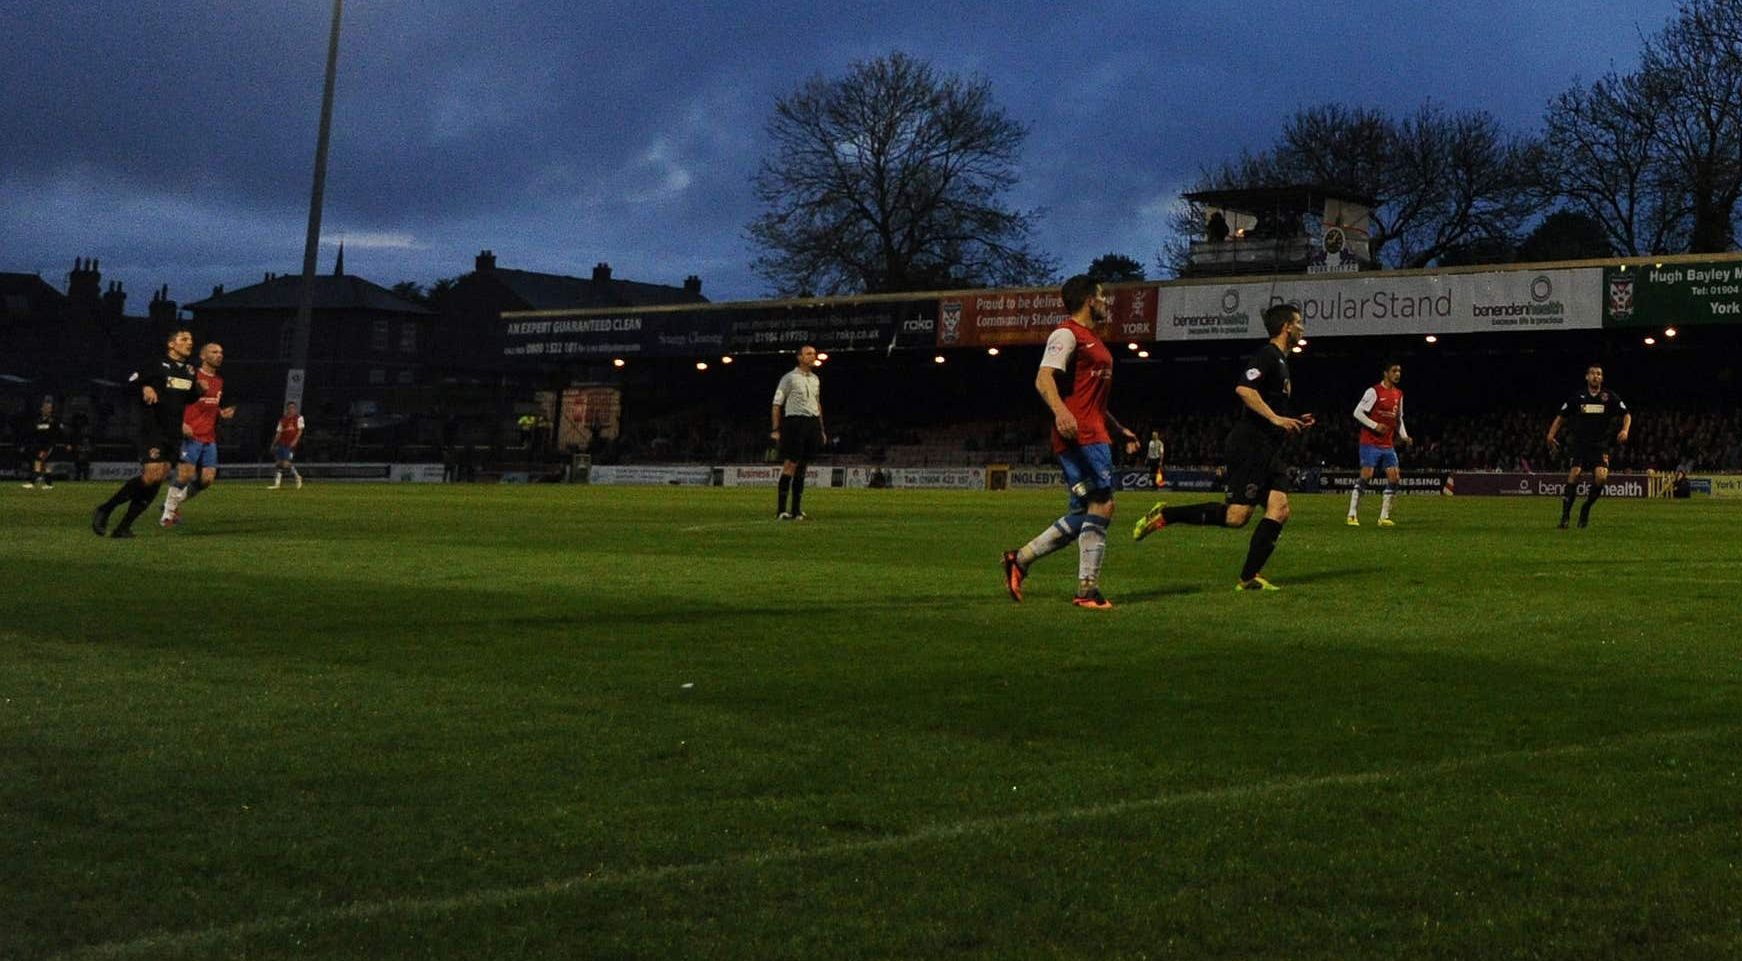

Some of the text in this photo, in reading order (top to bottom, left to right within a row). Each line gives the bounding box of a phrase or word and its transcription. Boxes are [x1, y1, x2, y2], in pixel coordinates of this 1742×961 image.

[1649, 270, 1683, 286] Hugh
[1686, 268, 1730, 284] Bayley
[1690, 286, 1709, 295] Tel:
[1710, 284, 1739, 295] 01904
[976, 296, 1005, 310] Proud
[1006, 297, 1016, 309] to
[1017, 296, 1031, 309] be
[1472, 301, 1565, 318] benendenhealth
[1710, 301, 1741, 314] York
[612, 318, 642, 332] CLEAN
[976, 313, 1030, 328] Community
[1122, 323, 1151, 333] YORK
